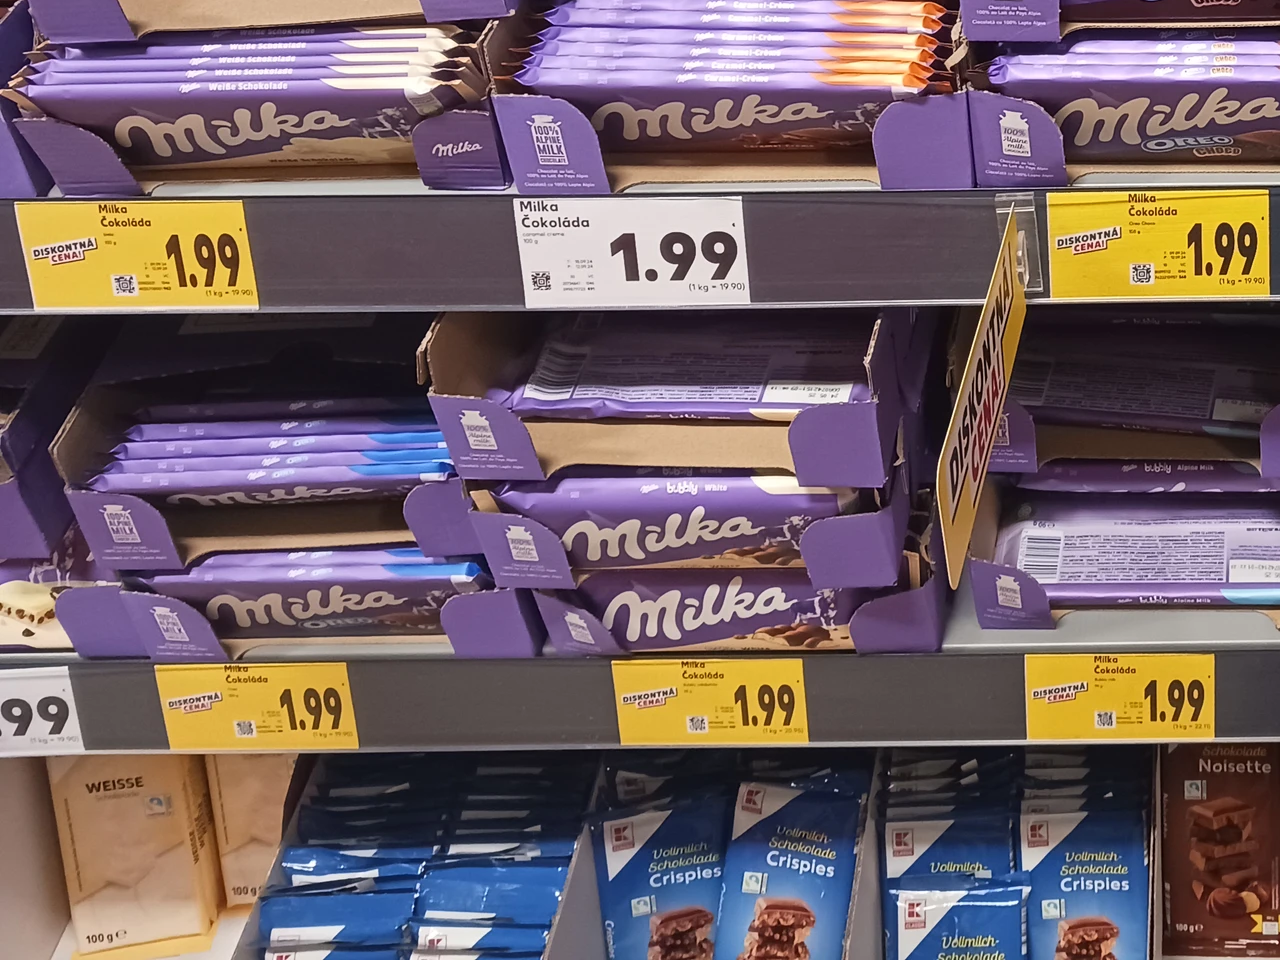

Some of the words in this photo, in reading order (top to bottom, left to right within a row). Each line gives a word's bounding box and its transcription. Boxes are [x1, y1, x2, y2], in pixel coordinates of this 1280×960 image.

[591, 95, 833, 141] Milka
[115, 102, 356, 157] Milka
[1147, 135, 1232, 151] OREO
[1194, 146, 1242, 157] CHOCO
[1128, 193, 1156, 203] Milka
[98, 204, 127, 214] Milka
[519, 201, 558, 212] Milka
[1128, 205, 1178, 217] Čokoláda
[100, 215, 151, 228] Čokoláda
[521, 214, 590, 228] Čokoláda
[1057, 228, 1119, 247] DISKONTNÁ
[33, 238, 94, 258] DISKONTNÁ
[1074, 240, 1105, 252] CENA!
[1187, 222, 1258, 276] 1.99
[51, 250, 82, 263] CENA!
[165, 233, 240, 288] 1.99
[610, 231, 738, 282] 1.99
[560, 506, 766, 561] Milka
[206, 585, 408, 628] Milka
[602, 576, 798, 642] Milka
[1094, 656, 1118, 664] Milka
[682, 670, 724, 679] Čokoláda
[1094, 665, 1137, 674] Čokoláda
[225, 675, 269, 684] Čokoláda
[622, 688, 676, 703] DISKONTNÁ
[1033, 682, 1086, 698] DISKONTNÁ
[168, 693, 220, 708] DISKONTNÁ
[734, 684, 795, 727] 1.99
[1144, 679, 1205, 722] 1.99
[279, 687, 343, 731] 1.99
[1199, 759, 1272, 773] Noisette
[86, 776, 144, 794] WEISSE
[769, 838, 837, 860] Schokolade
[1065, 852, 1122, 862] Vollmilch-
[766, 850, 835, 878] Crispies
[1060, 864, 1129, 876] Schokolade
[650, 866, 722, 888] Crispies
[1060, 877, 1129, 893] Crispies
